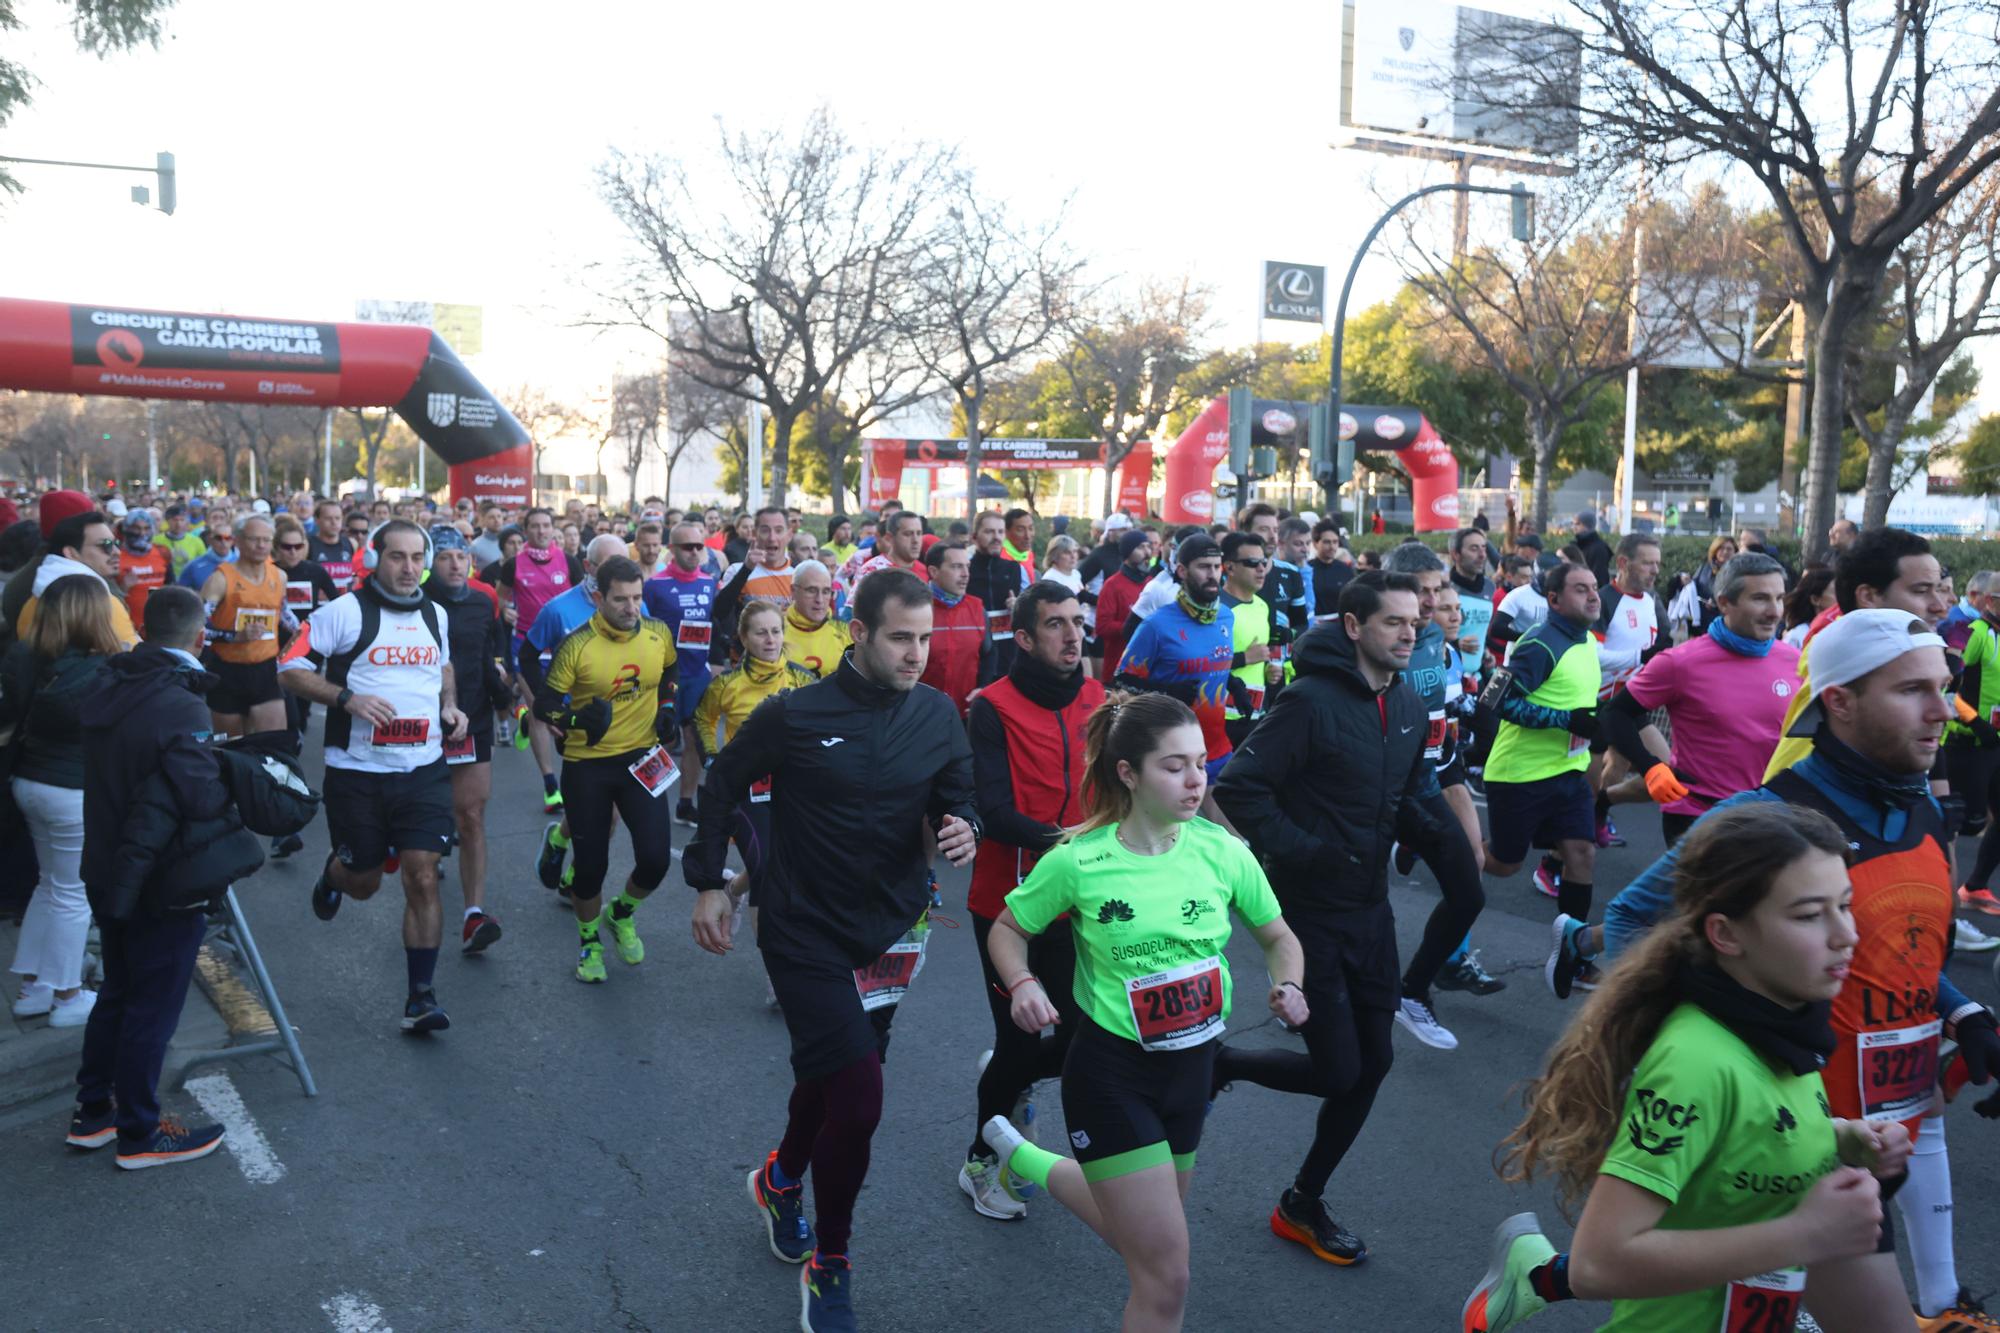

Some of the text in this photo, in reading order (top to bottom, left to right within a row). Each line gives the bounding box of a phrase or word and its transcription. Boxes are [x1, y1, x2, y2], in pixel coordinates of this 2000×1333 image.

[1268, 302, 1321, 318] LEXUS
[91, 311, 319, 340] CIRCUIT DE CARRERES
[99, 372, 227, 391] #ValènciaCorre
[1143, 975, 1214, 1023] 2859
